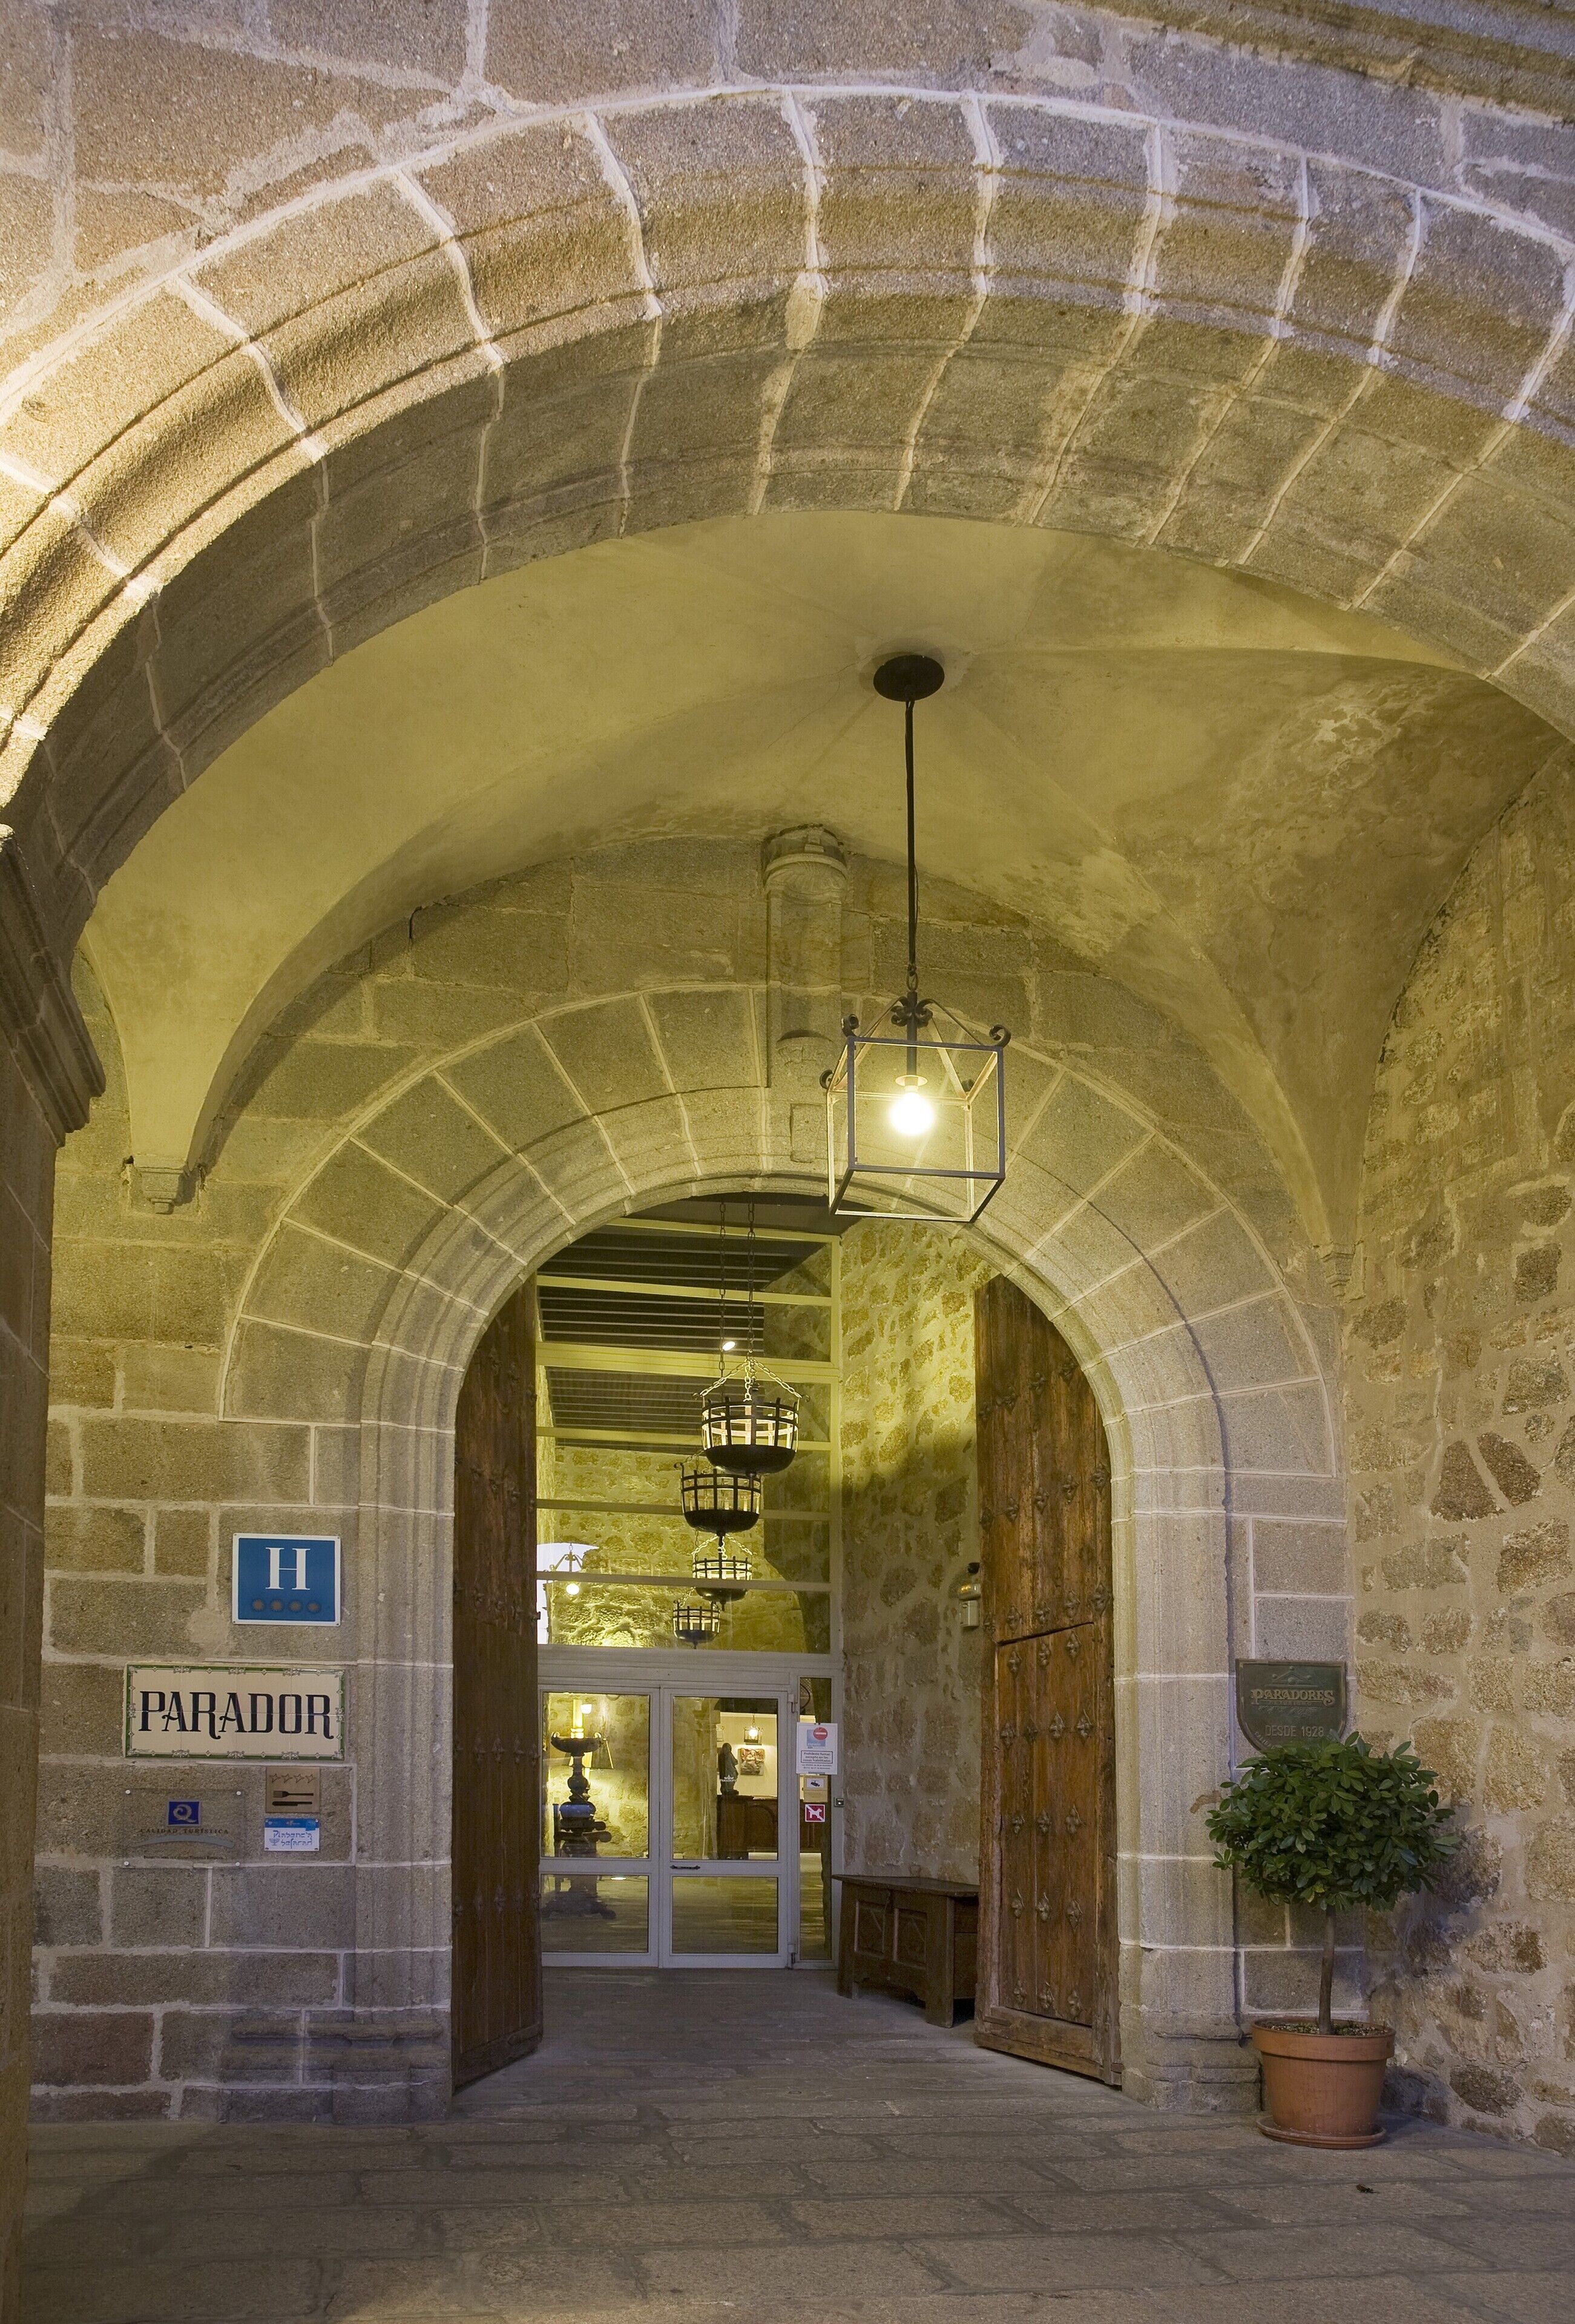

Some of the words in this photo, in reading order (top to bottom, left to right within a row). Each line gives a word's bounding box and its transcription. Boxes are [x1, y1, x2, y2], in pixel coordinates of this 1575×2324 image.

[265, 1547, 311, 1590] H
[1251, 1689, 1335, 1707] PARADORES
[138, 1690, 334, 1740] PARADOR
[1264, 1725, 1297, 1736] DESDE
[1301, 1725, 1324, 1738] 1928
